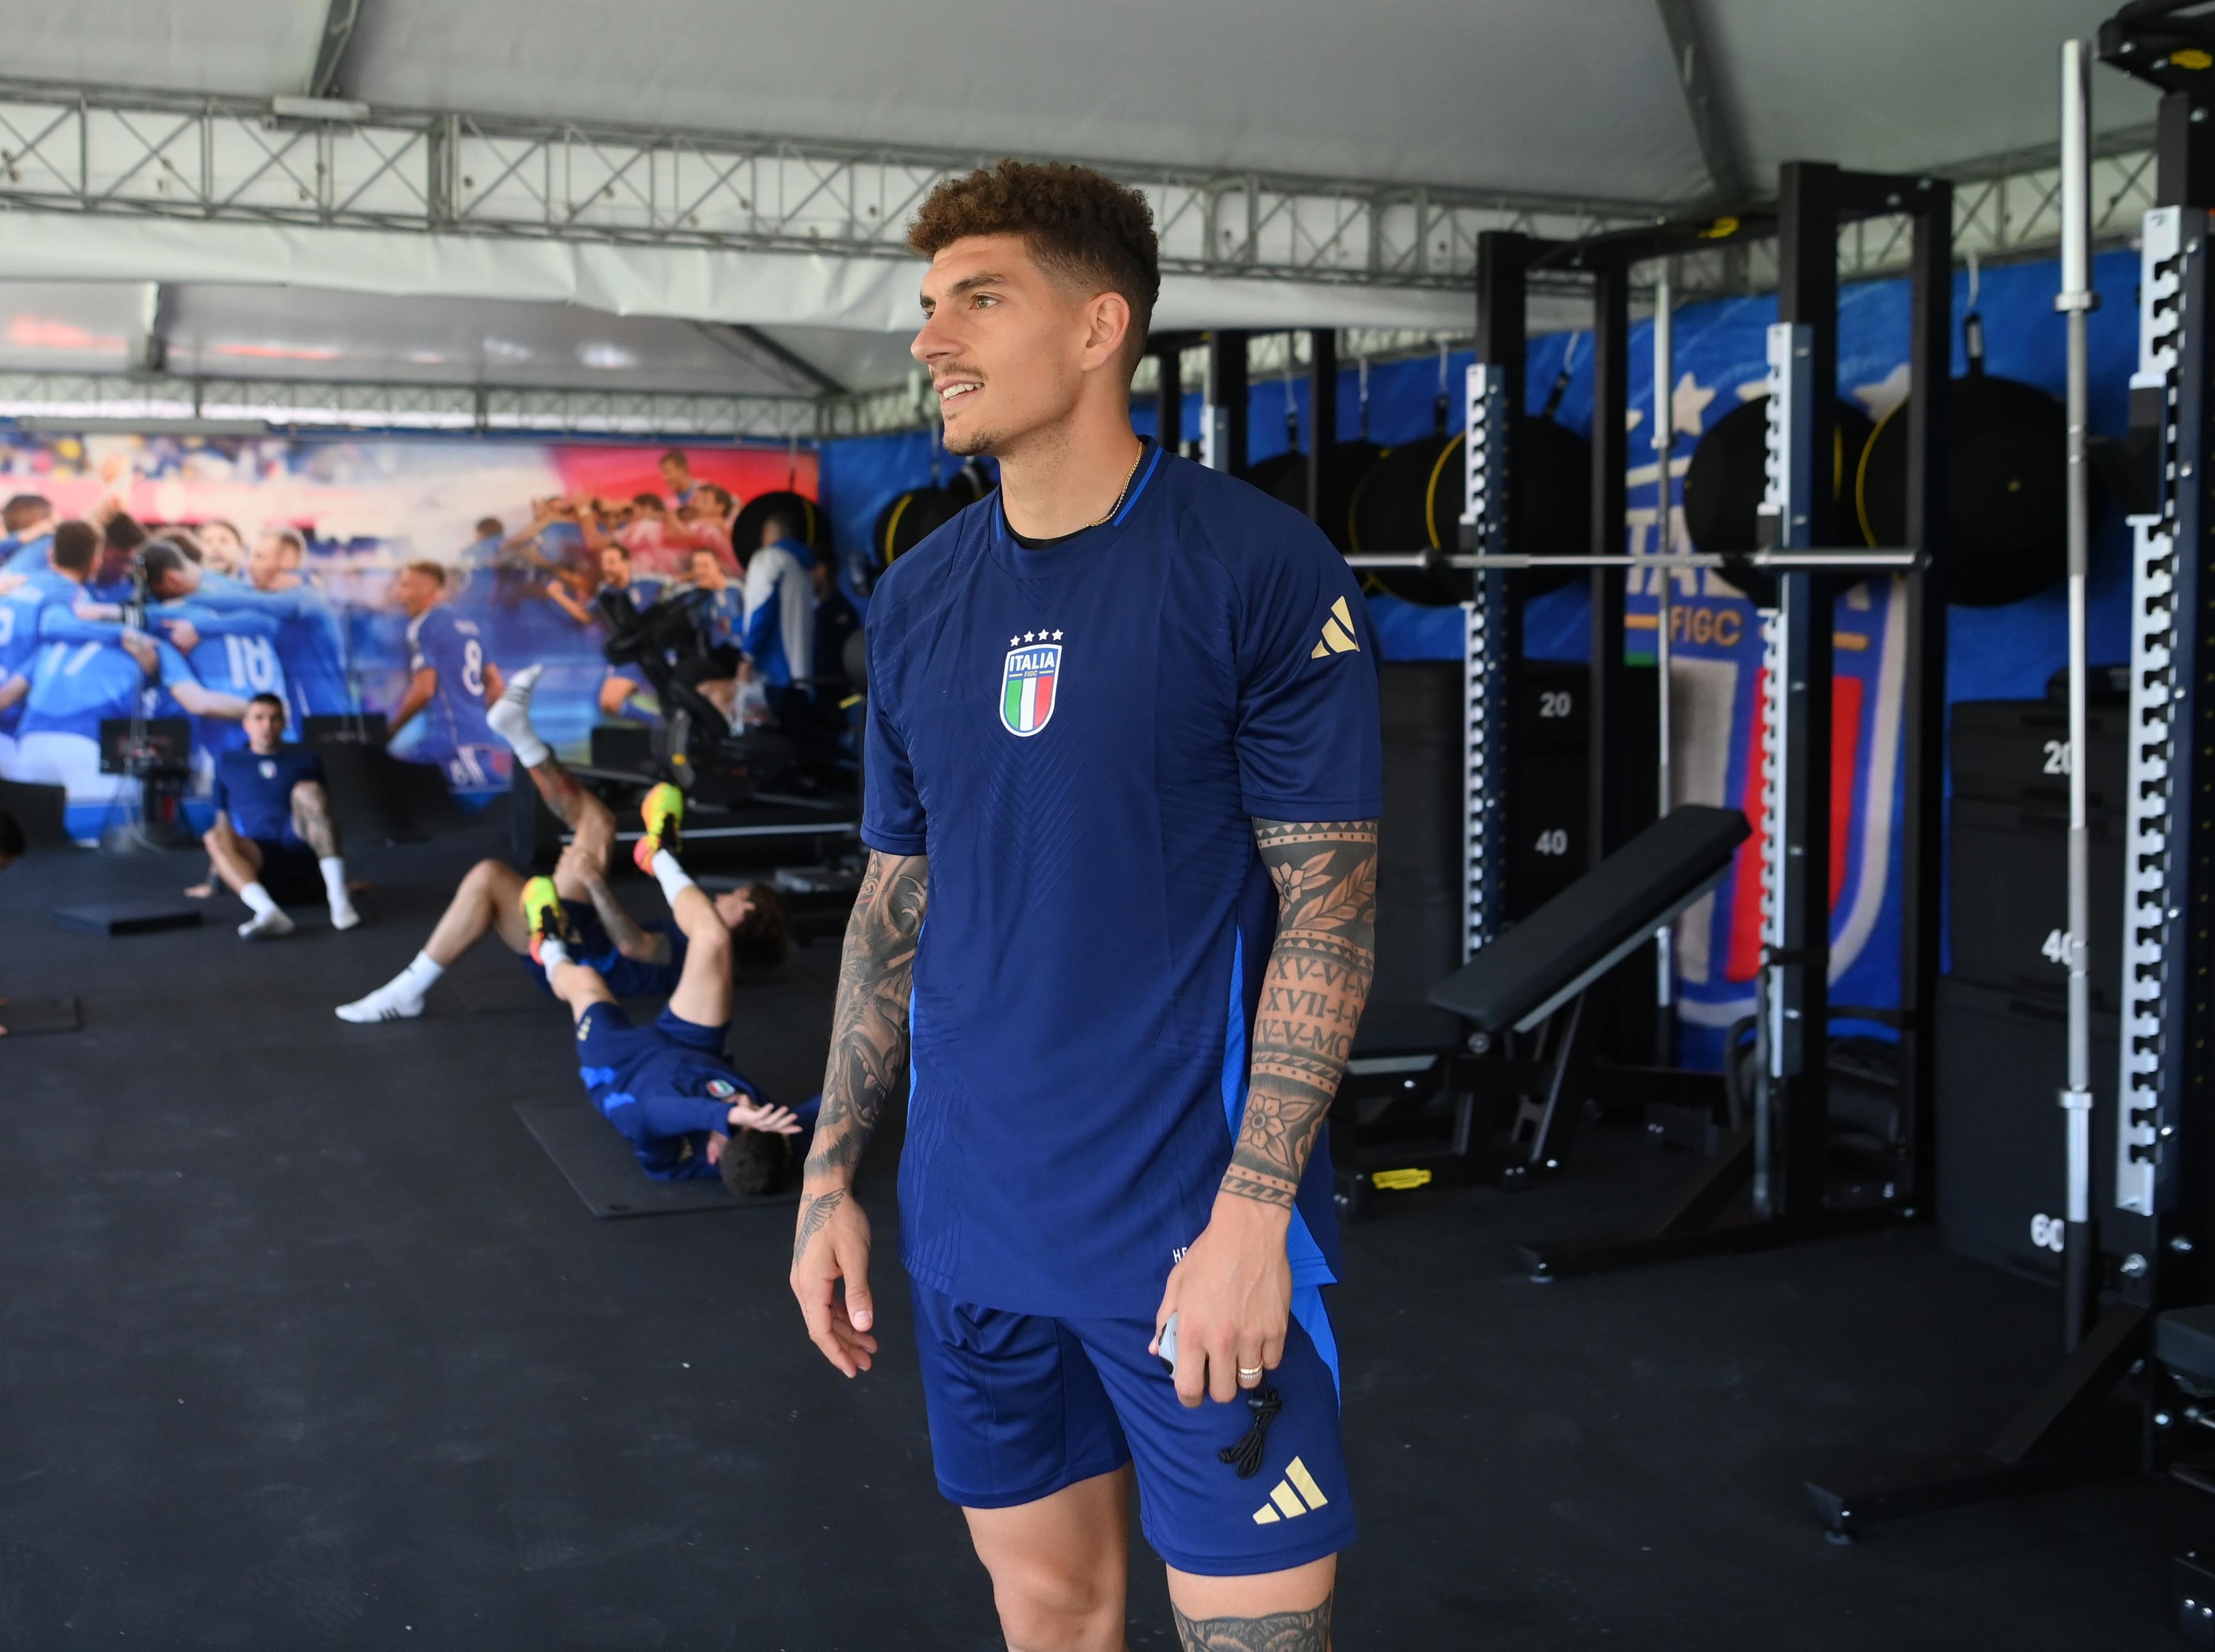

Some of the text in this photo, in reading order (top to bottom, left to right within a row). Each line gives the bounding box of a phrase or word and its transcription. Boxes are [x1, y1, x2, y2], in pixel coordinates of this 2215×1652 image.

[1669, 605, 1743, 647] FIGC
[1009, 652, 1054, 671] ITALIA
[1539, 692, 1573, 718] 20
[1534, 828, 1568, 856] 40
